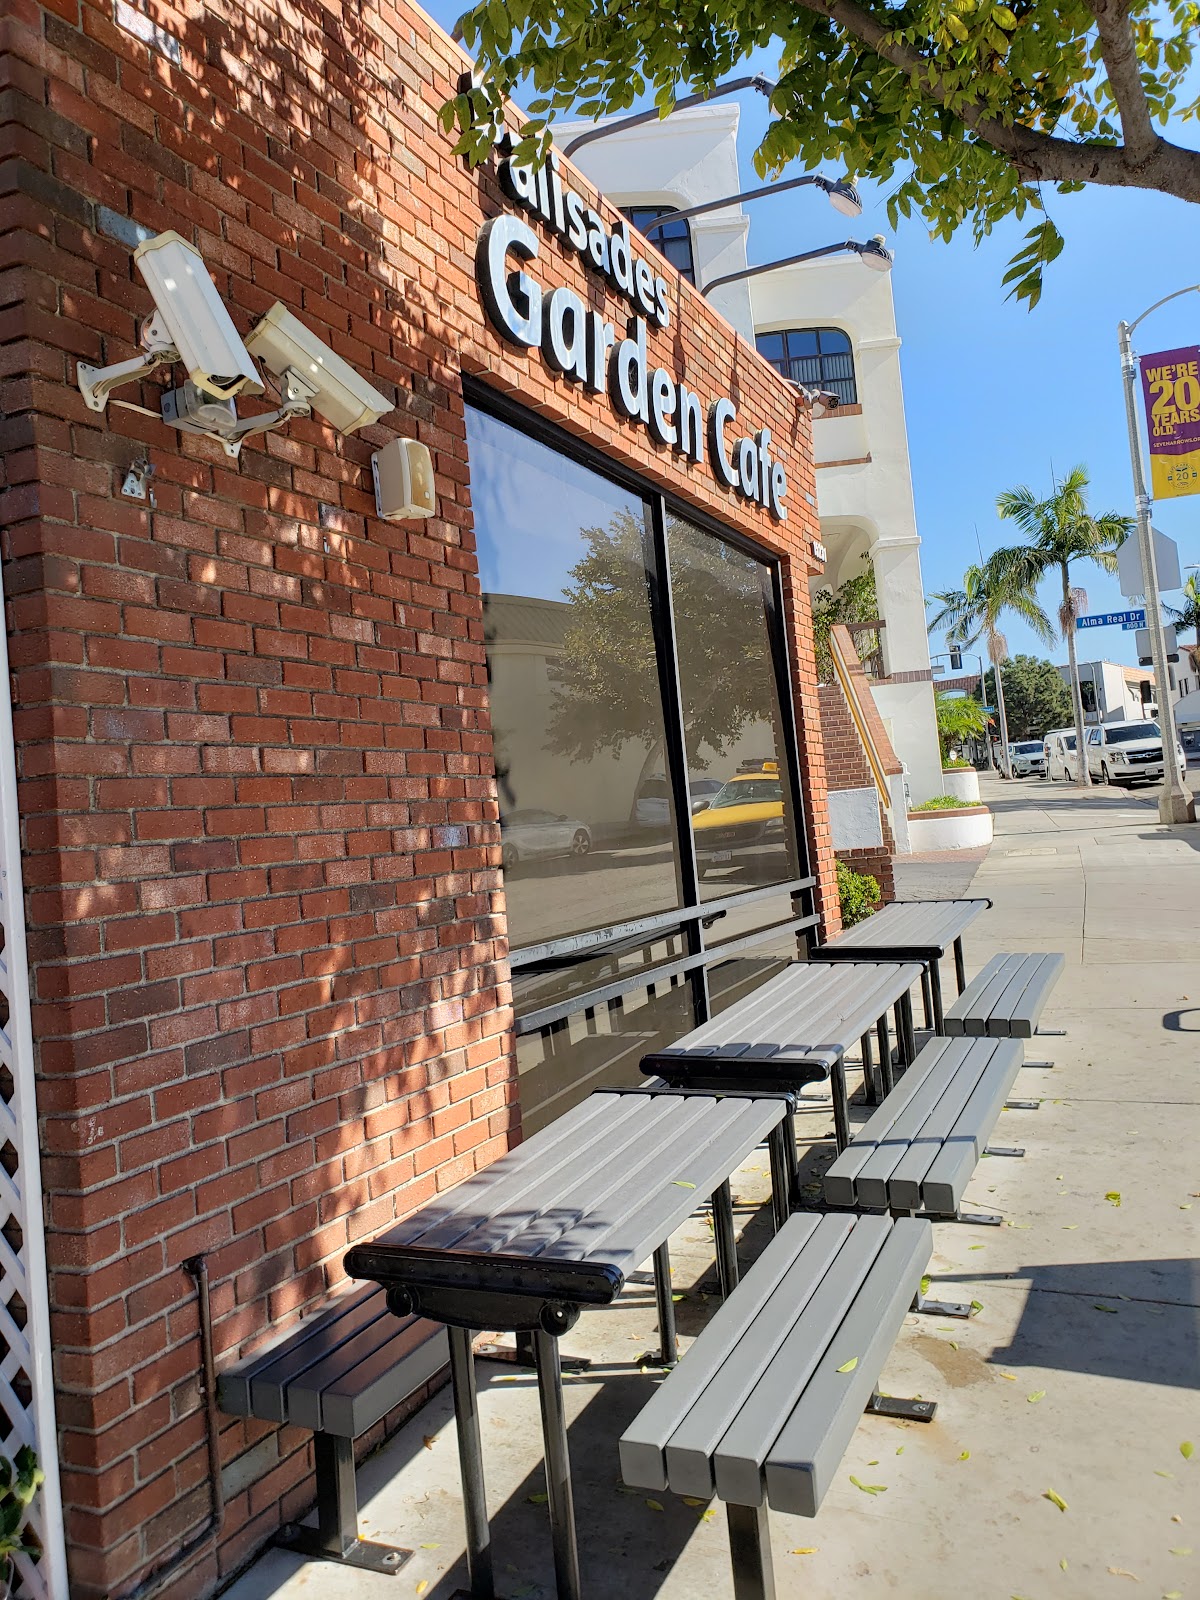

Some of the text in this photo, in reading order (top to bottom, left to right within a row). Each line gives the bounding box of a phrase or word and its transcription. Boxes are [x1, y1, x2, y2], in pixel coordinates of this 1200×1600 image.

[480, 214, 789, 521] Garden Cafe
[1146, 361, 1199, 382] WE'RE
[1149, 375, 1200, 416] 20
[1151, 409, 1200, 428] YEARS
[1153, 425, 1177, 437] OLD.
[1082, 612, 1140, 627] Alma Real Dr
